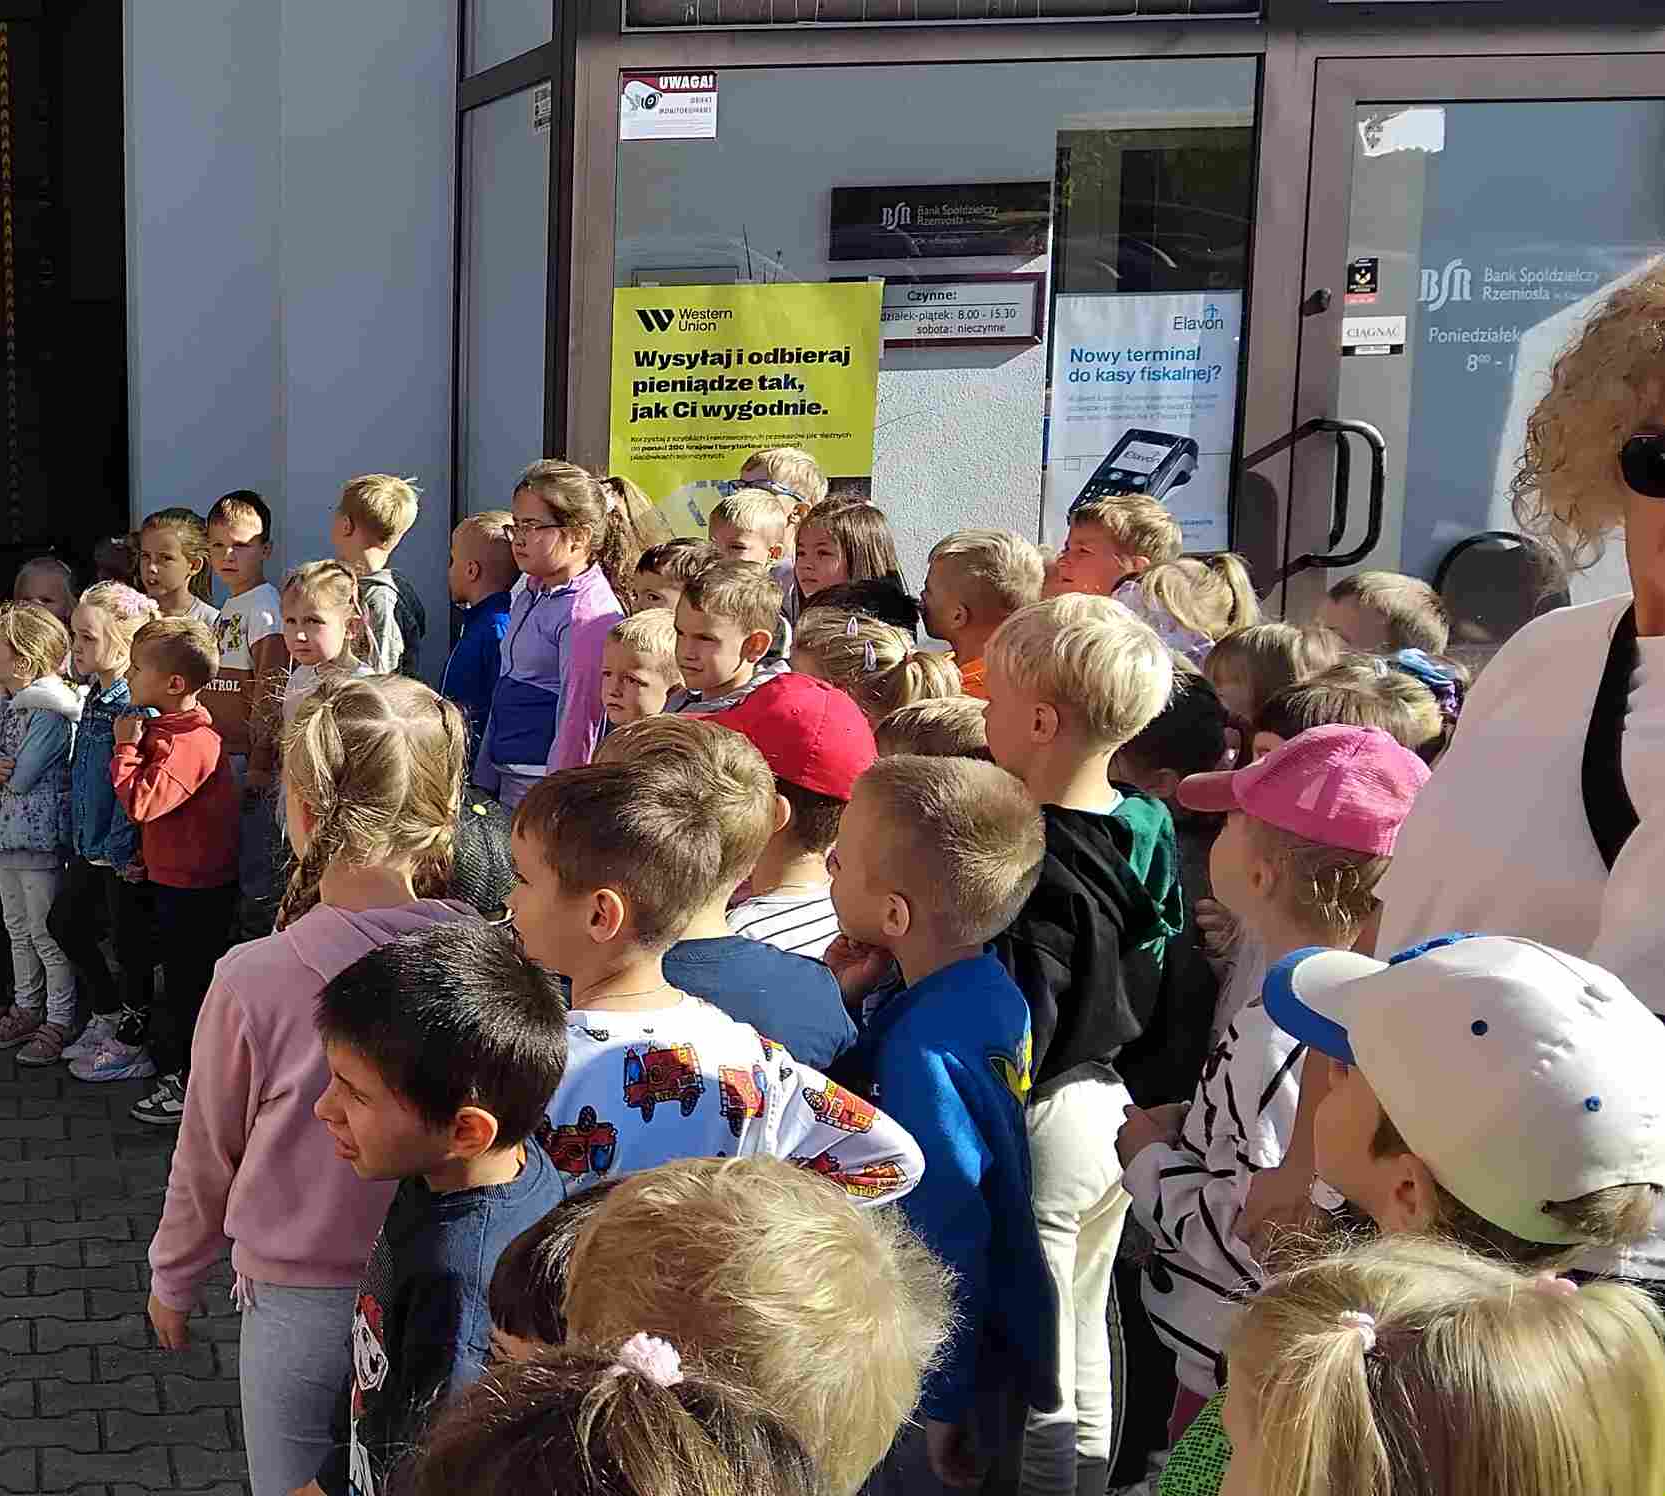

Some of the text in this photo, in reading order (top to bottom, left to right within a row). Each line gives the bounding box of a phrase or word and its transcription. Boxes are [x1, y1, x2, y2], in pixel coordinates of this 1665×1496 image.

[659, 75, 713, 90] UWAGA!
[1484, 266, 1516, 282] Bank
[907, 289, 957, 302] Czynne:
[679, 308, 733, 320] Western
[679, 321, 717, 332] Union
[916, 323, 1007, 335] sobota: nieczynne
[1174, 316, 1224, 330] Elavon
[634, 346, 851, 371] Wysyłaj i odbieraj
[1070, 345, 1202, 365] Nowy terminal
[1069, 364, 1223, 384] do kasy fiskalnej?
[633, 373, 805, 397] pieniądze tak,
[631, 400, 829, 424] jak Ci wygodnie.
[204, 679, 241, 692] ATROL
